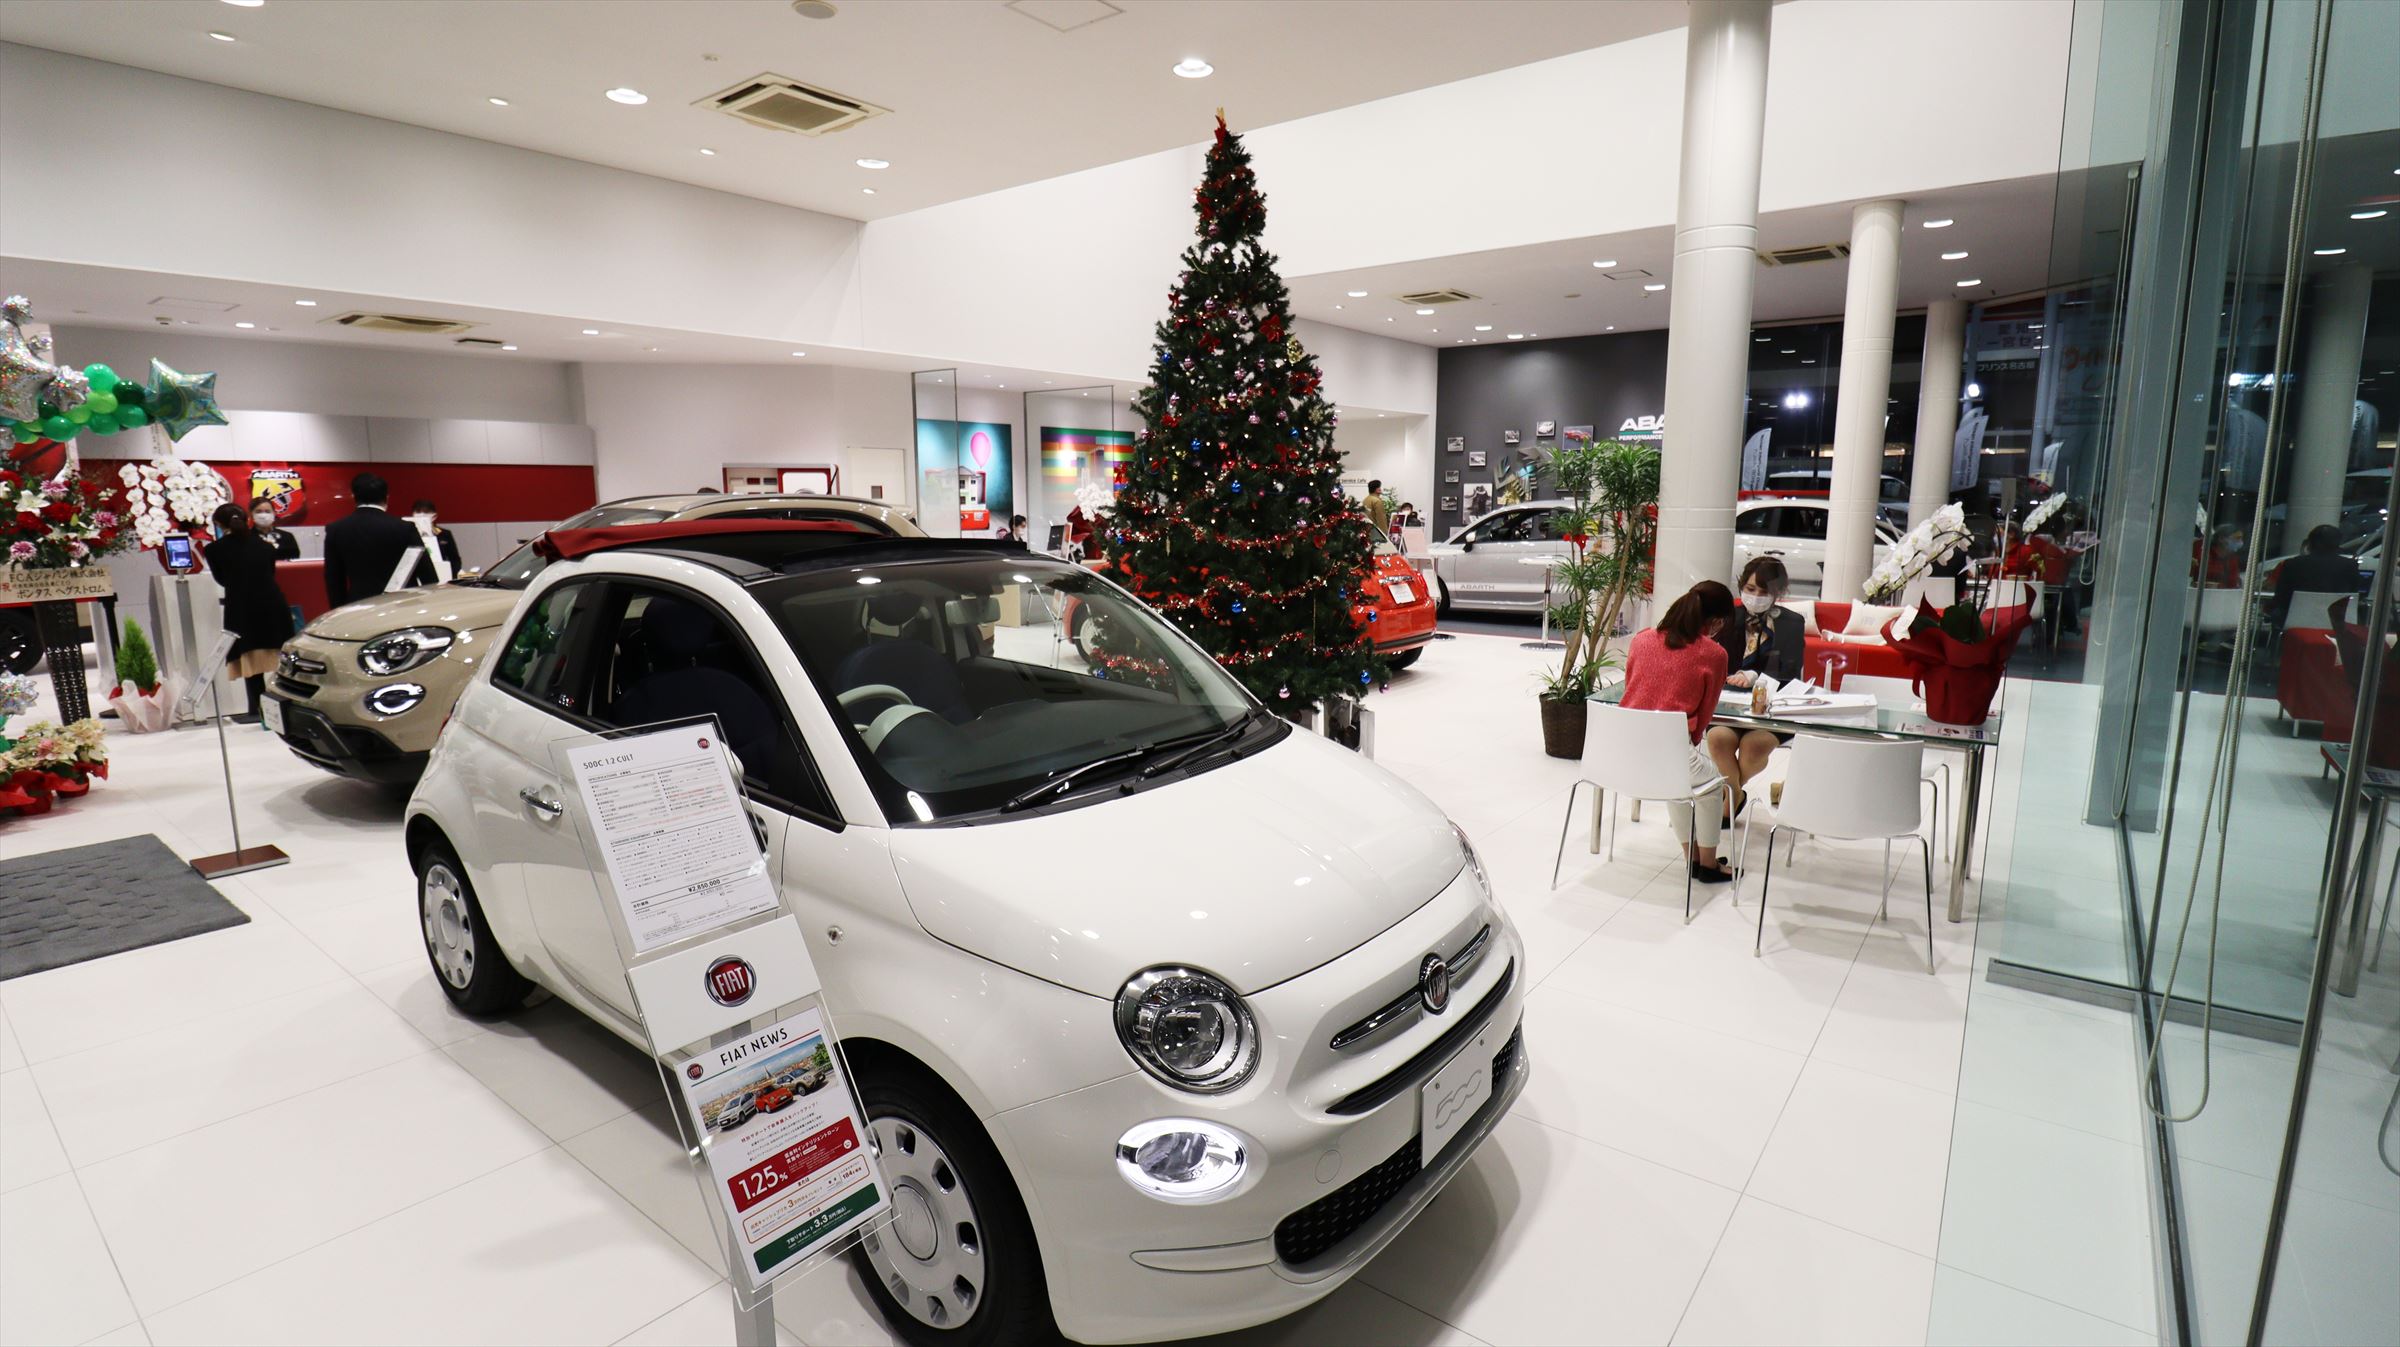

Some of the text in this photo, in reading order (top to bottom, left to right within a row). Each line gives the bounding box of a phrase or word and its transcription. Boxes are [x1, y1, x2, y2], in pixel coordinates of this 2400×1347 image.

[252, 469, 299, 479] ABARTH
[583, 759, 604, 770] 500C
[617, 753, 634, 763] CULT
[715, 966, 746, 996] FIAT
[719, 1027, 788, 1066] FIAT NEWS
